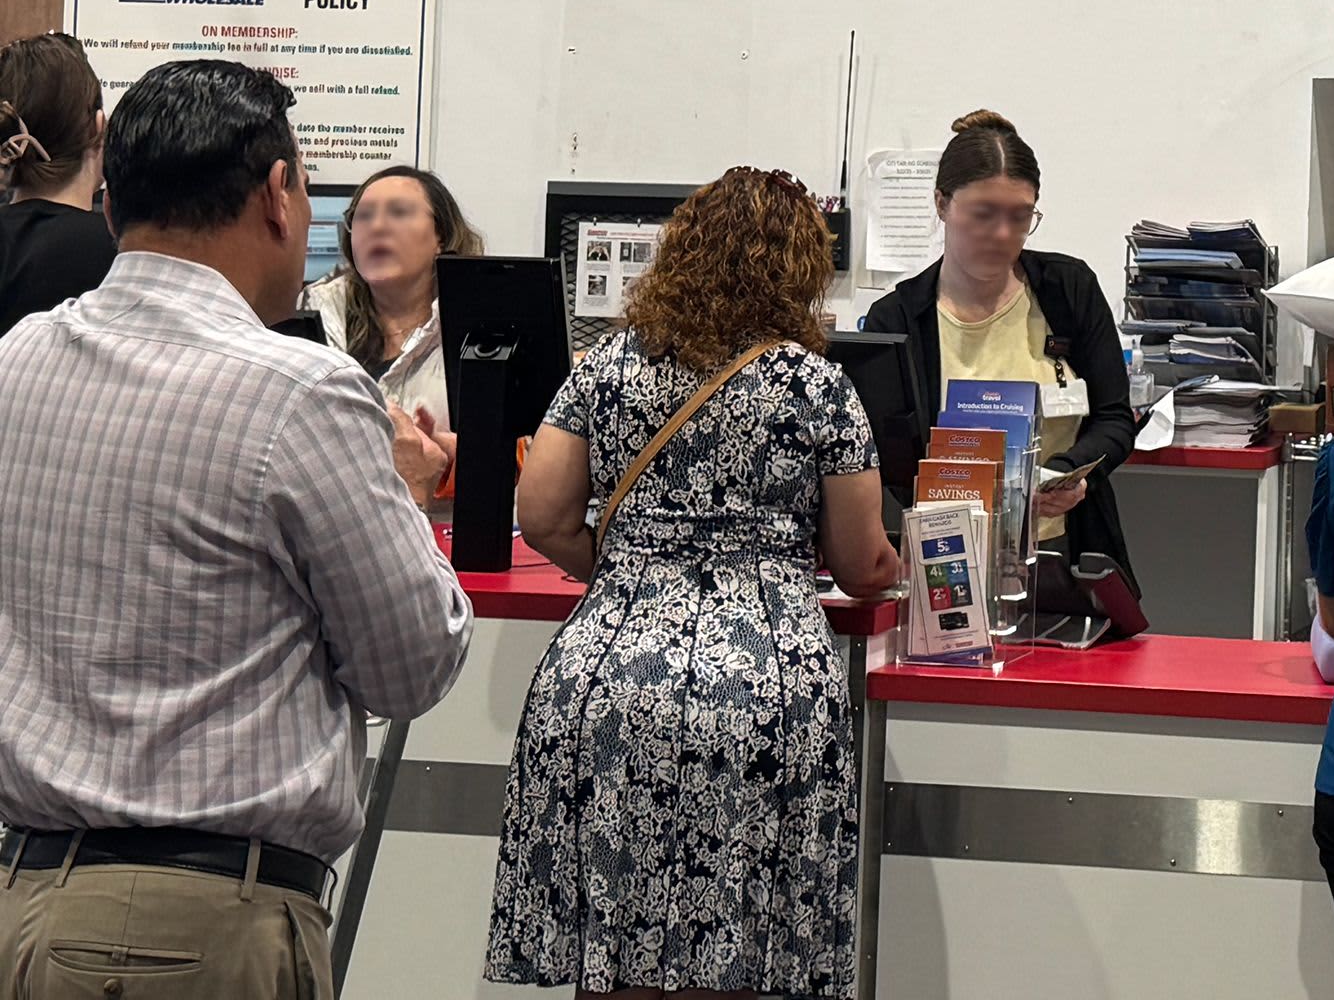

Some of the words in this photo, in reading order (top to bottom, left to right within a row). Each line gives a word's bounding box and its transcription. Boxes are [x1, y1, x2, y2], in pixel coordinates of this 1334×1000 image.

[202, 25, 218, 38] ON
[220, 25, 299, 39] MEMBERSHIP:
[101, 38, 119, 49] will
[150, 41, 170, 52] your
[172, 41, 225, 53] membership
[253, 42, 269, 53] full
[270, 43, 279, 53] at
[280, 44, 296, 55] any
[298, 43, 317, 54] time
[327, 45, 344, 56] you
[326, 84, 346, 95] with
[355, 85, 369, 95] full
[957, 402, 993, 410] Introduction
[1000, 403, 1024, 412] Cruising
[928, 488, 981, 500] SAVINGS
